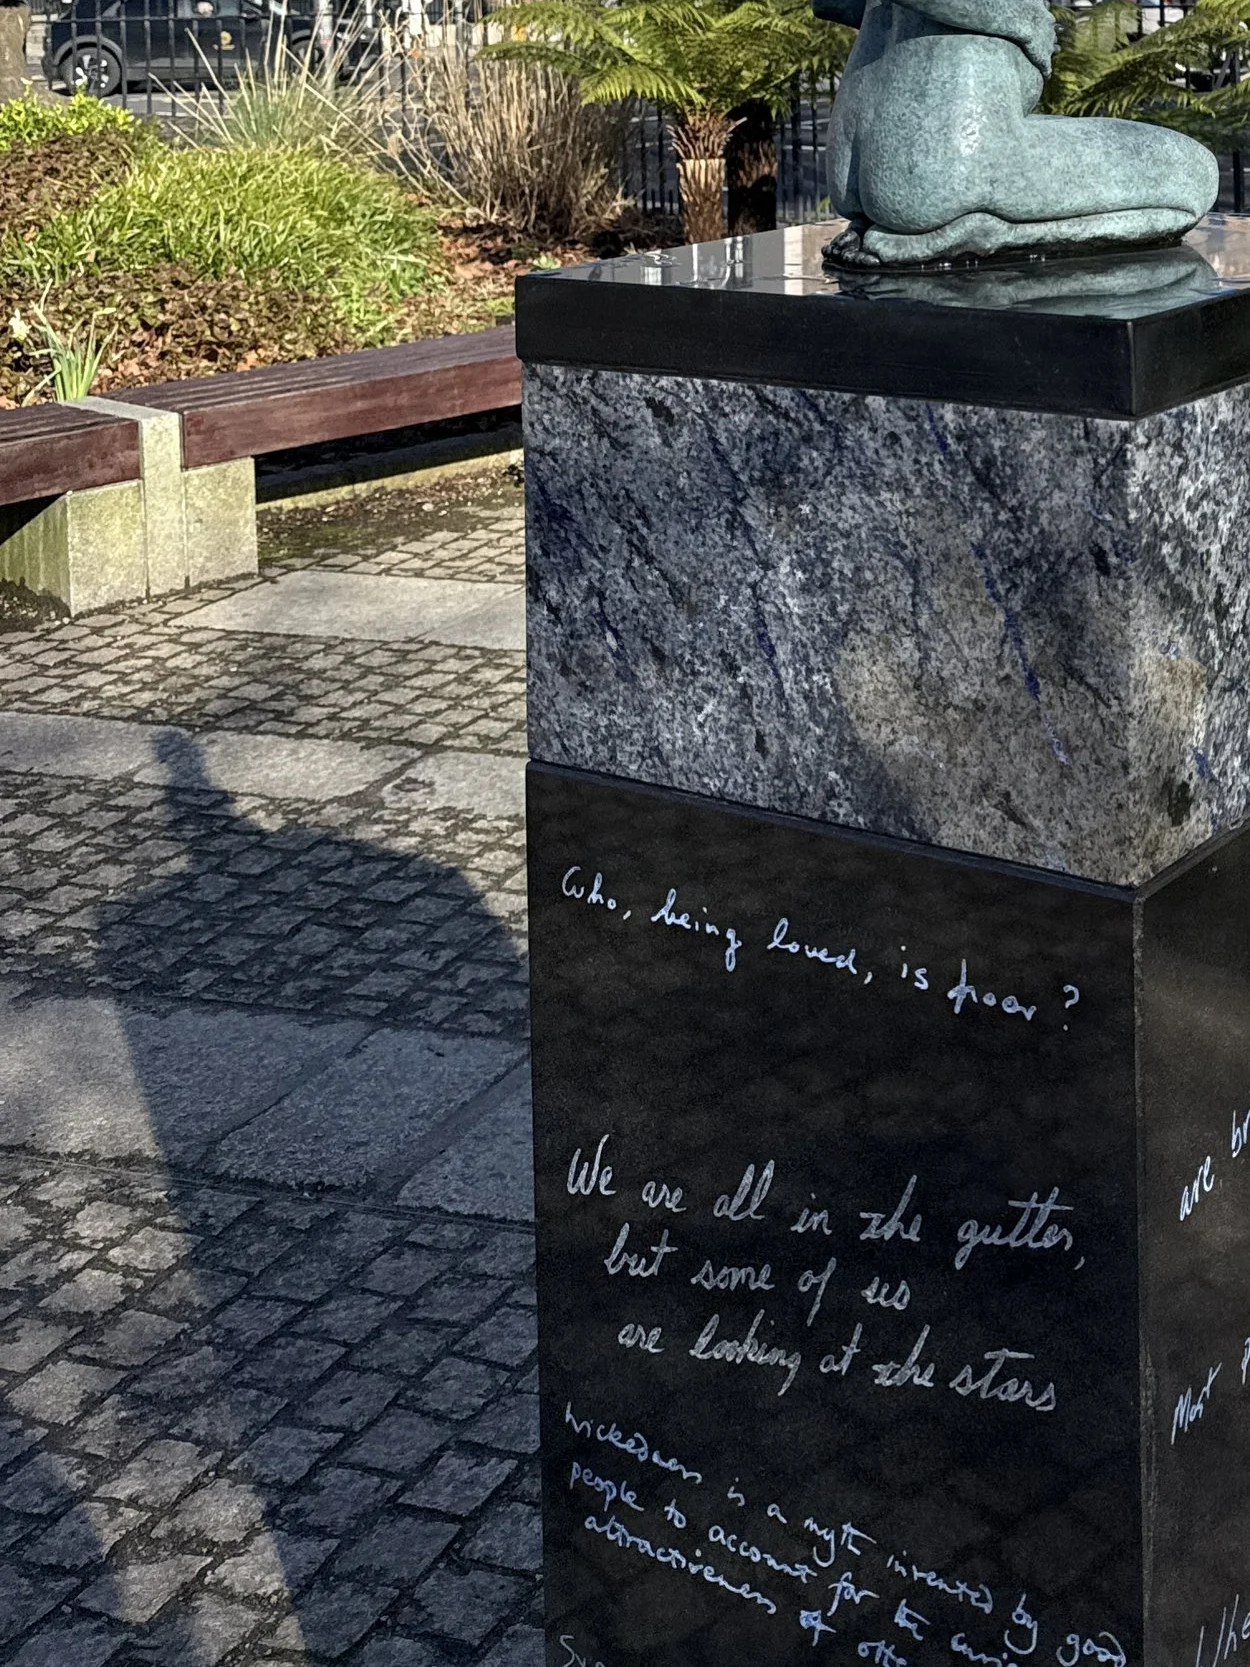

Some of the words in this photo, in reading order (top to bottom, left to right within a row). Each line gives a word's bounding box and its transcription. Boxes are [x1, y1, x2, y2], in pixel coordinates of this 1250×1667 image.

[651, 888, 742, 972] being
[900, 945, 928, 990] is
[567, 1135, 616, 1195] We
[641, 1177, 687, 1213] are
[713, 1159, 774, 1220] all
[791, 1193, 832, 1234] in
[860, 1175, 921, 1241] the
[957, 1186, 1085, 1270] gutter,
[1179, 1156, 1215, 1221] are
[605, 1223, 678, 1276] but
[691, 1254, 775, 1291] some
[799, 1258, 836, 1326] of
[863, 1275, 911, 1310] us
[618, 1322, 664, 1353] are
[690, 1309, 800, 1395] looking
[820, 1323, 861, 1375] at
[872, 1324, 934, 1387] the
[949, 1348, 1056, 1410] stars
[1171, 1362, 1222, 1445] Most
[570, 1462, 644, 1512] people
[664, 1498, 687, 1528] to
[708, 1525, 817, 1583] account
[827, 1571, 880, 1617] for
[894, 1598, 931, 1641] the
[584, 1515, 777, 1614] attractiveness
[727, 1477, 745, 1506] is
[767, 1503, 787, 1524] a
[887, 1550, 992, 1614] invented
[1004, 1593, 1038, 1655] by
